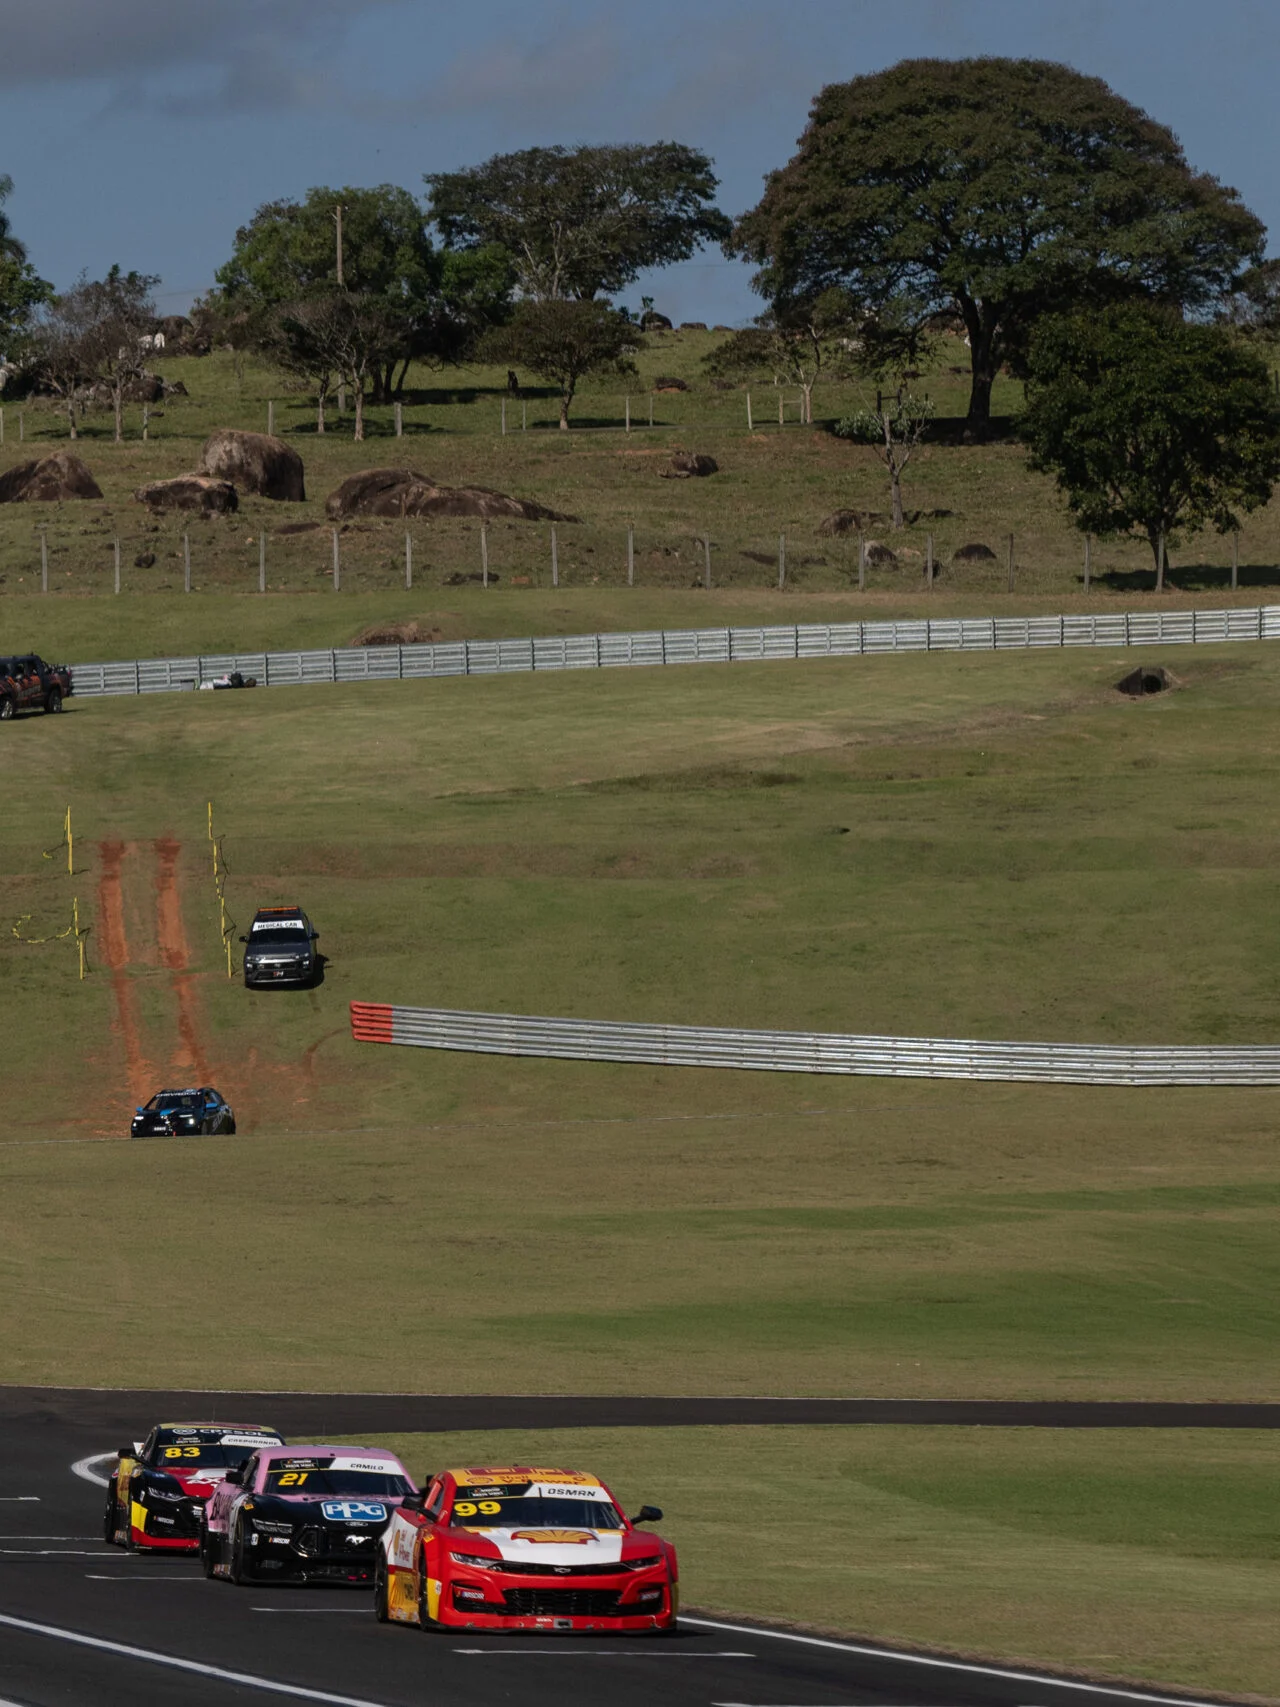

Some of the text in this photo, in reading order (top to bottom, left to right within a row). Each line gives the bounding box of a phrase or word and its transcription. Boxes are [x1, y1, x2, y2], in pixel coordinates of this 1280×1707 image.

[199, 1429, 267, 1437] CRESOL
[165, 1447, 201, 1458] 83
[278, 1473, 308, 1486] 21
[548, 1488, 596, 1497] OSMAN
[326, 1502, 383, 1518] PPG
[454, 1501, 502, 1517] 99
